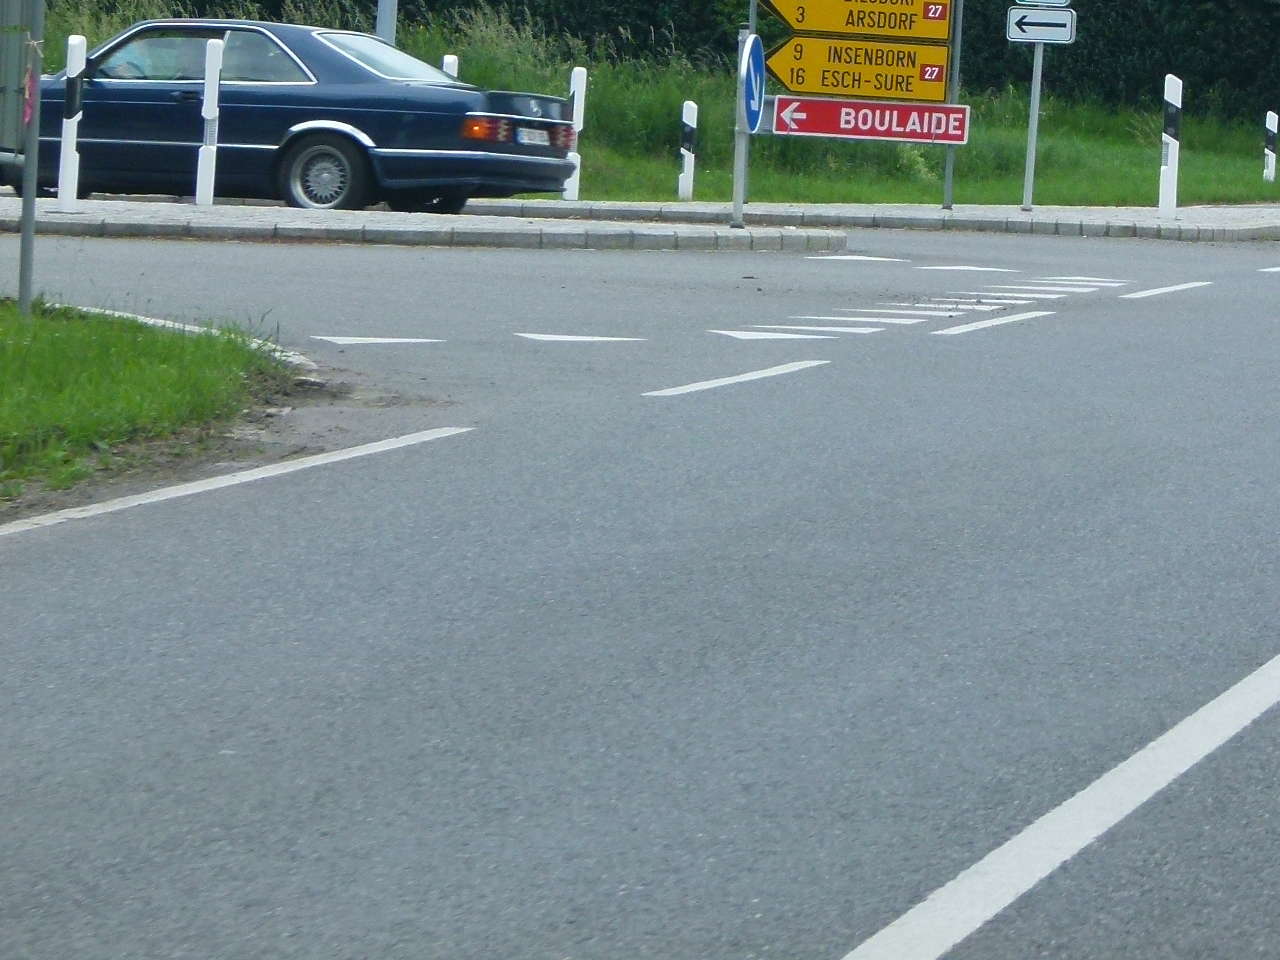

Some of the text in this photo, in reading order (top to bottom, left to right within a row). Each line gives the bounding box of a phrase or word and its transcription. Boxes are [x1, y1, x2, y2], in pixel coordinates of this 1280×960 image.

[796, 6, 918, 30] 3 ARSDORF
[928, 5, 943, 18] 27
[793, 43, 917, 68] 9 INSENBORN
[789, 68, 914, 92] 16 ESCH-SURE
[924, 67, 939, 80] 27
[840, 107, 963, 135] BOULAIDE
